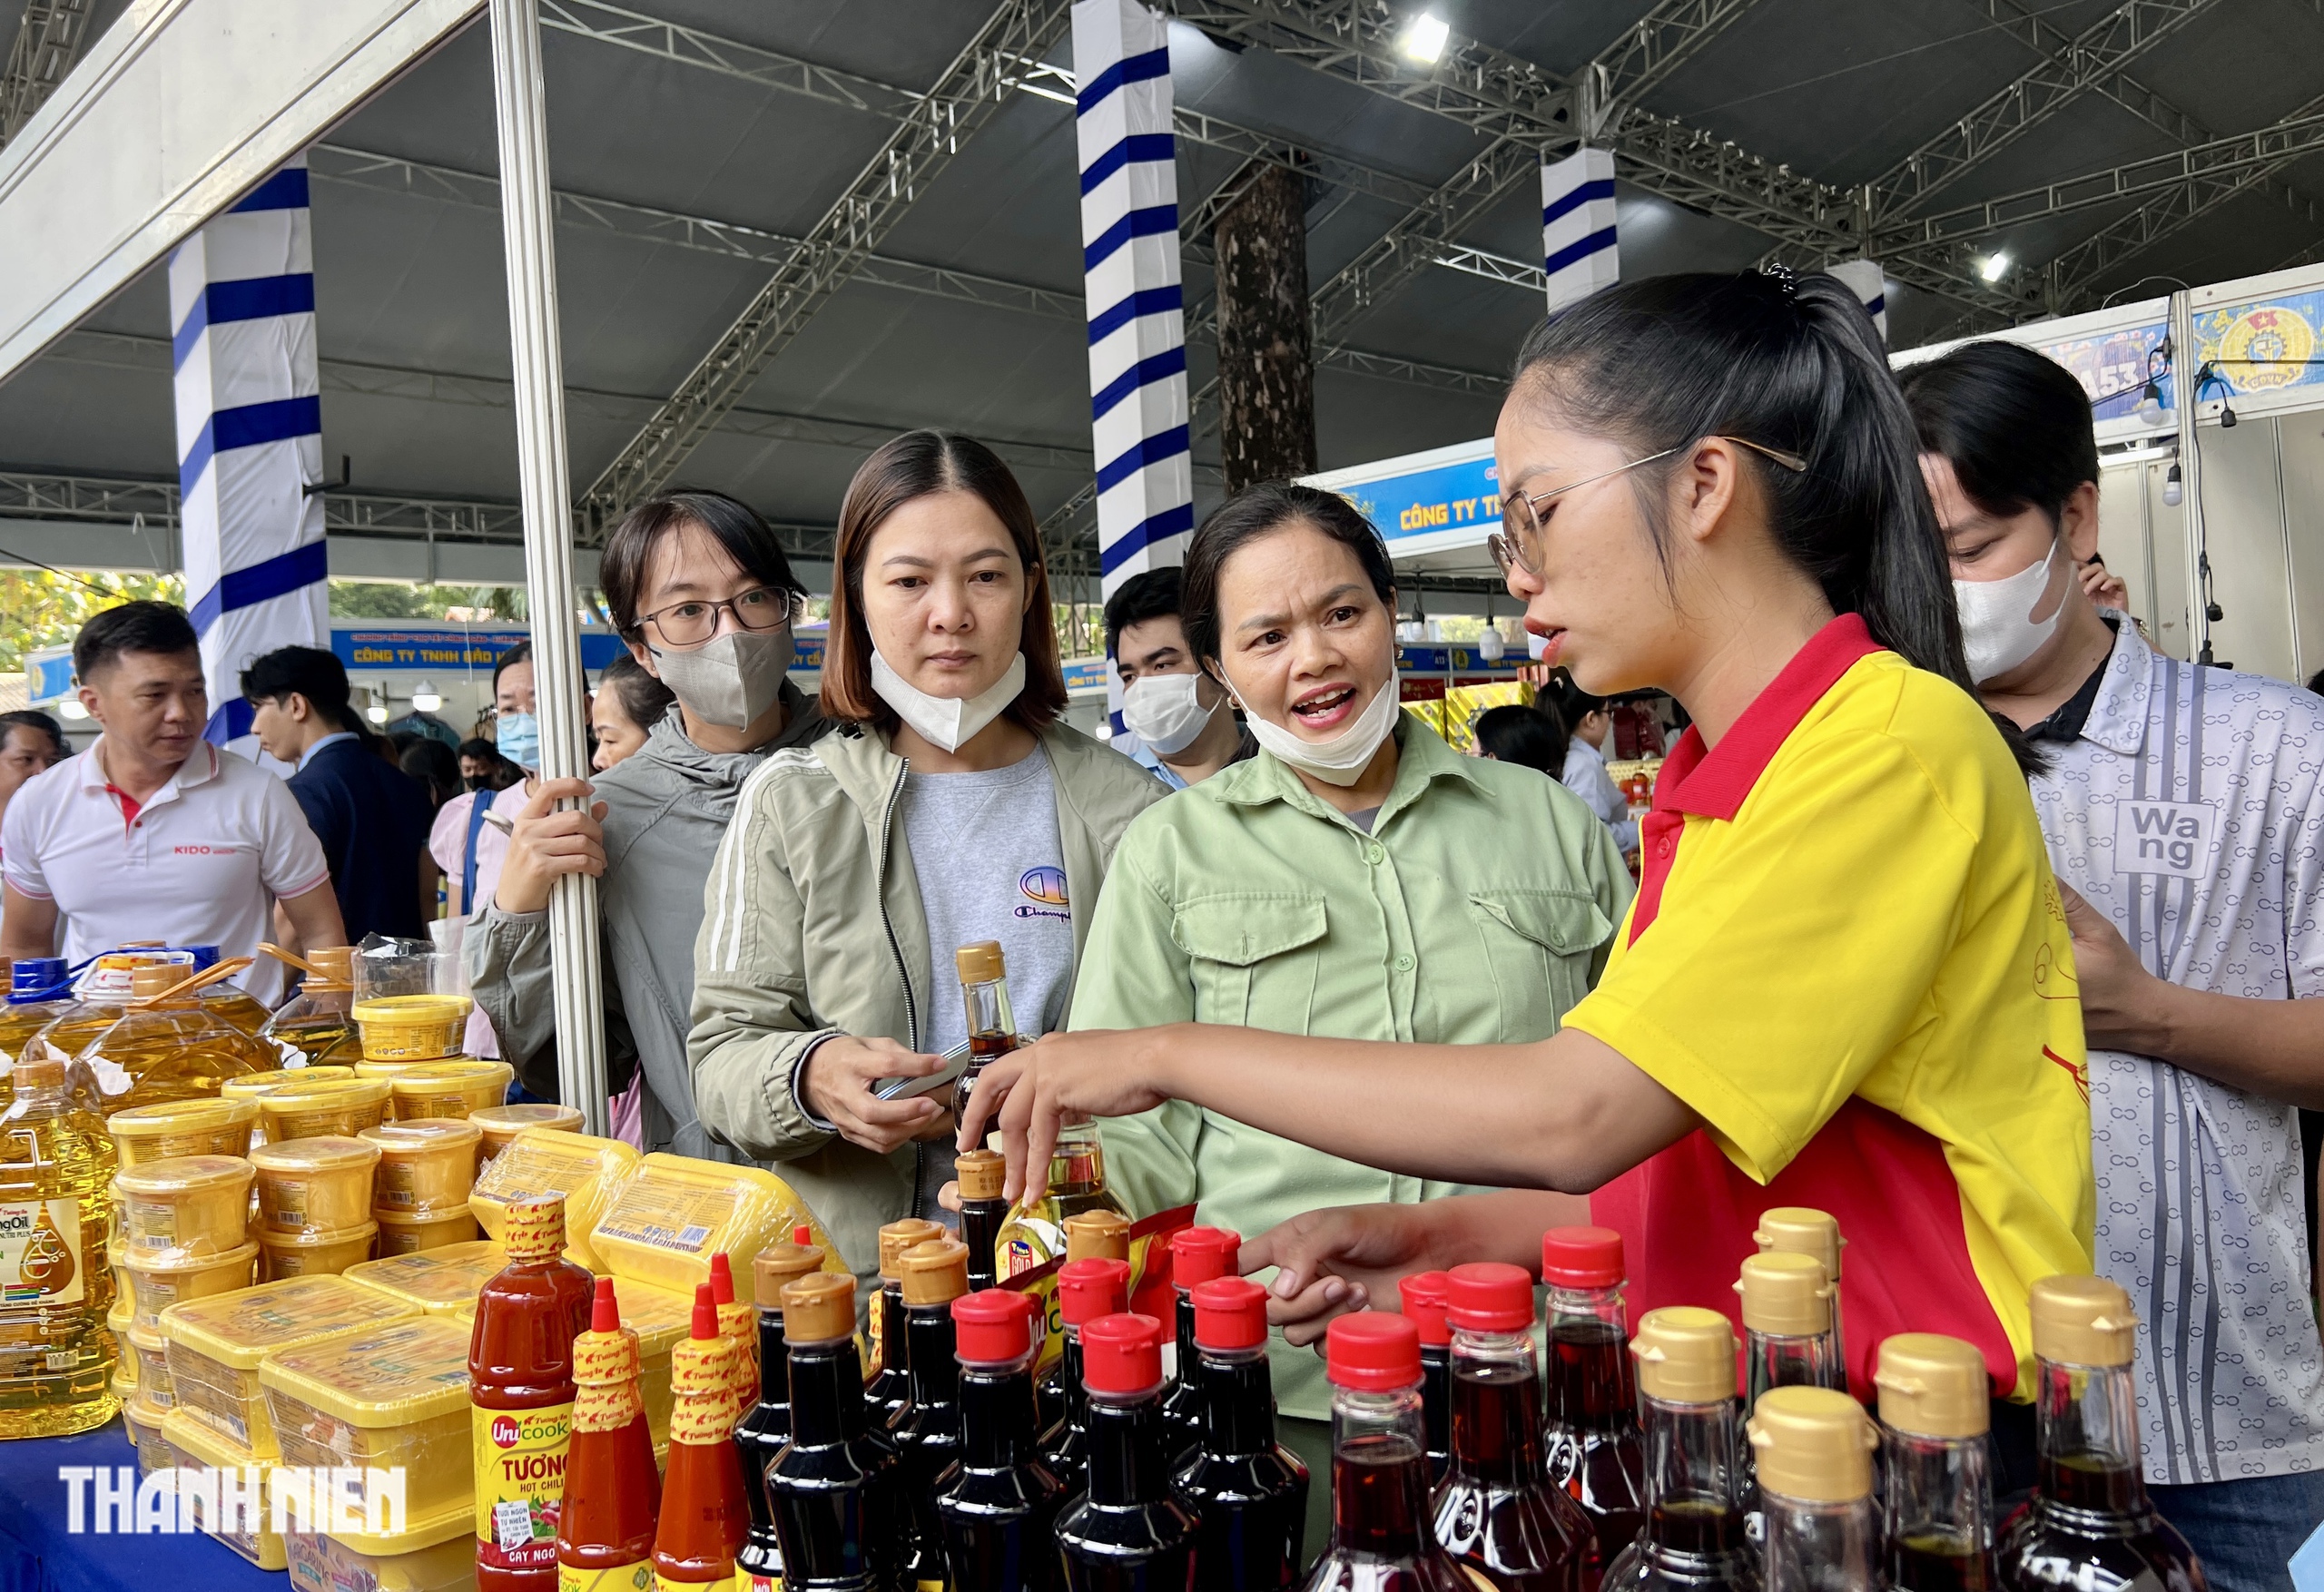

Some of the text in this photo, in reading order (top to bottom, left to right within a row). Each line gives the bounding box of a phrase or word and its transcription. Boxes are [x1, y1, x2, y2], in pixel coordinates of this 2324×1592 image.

[2079, 361, 2140, 400] A53
[1400, 502, 1449, 531] CÔNG
[1452, 497, 1478, 522] TY
[353, 646, 393, 663] CÔNG
[398, 649, 416, 663] TY
[419, 650, 459, 663] TNHH
[2131, 807, 2200, 840] Wa
[174, 845, 211, 855] KIDO
[2139, 838, 2193, 870] ng
[502, 1453, 568, 1481] TƯƠN
[520, 1481, 537, 1493] HOT
[508, 1551, 529, 1563] CAY
